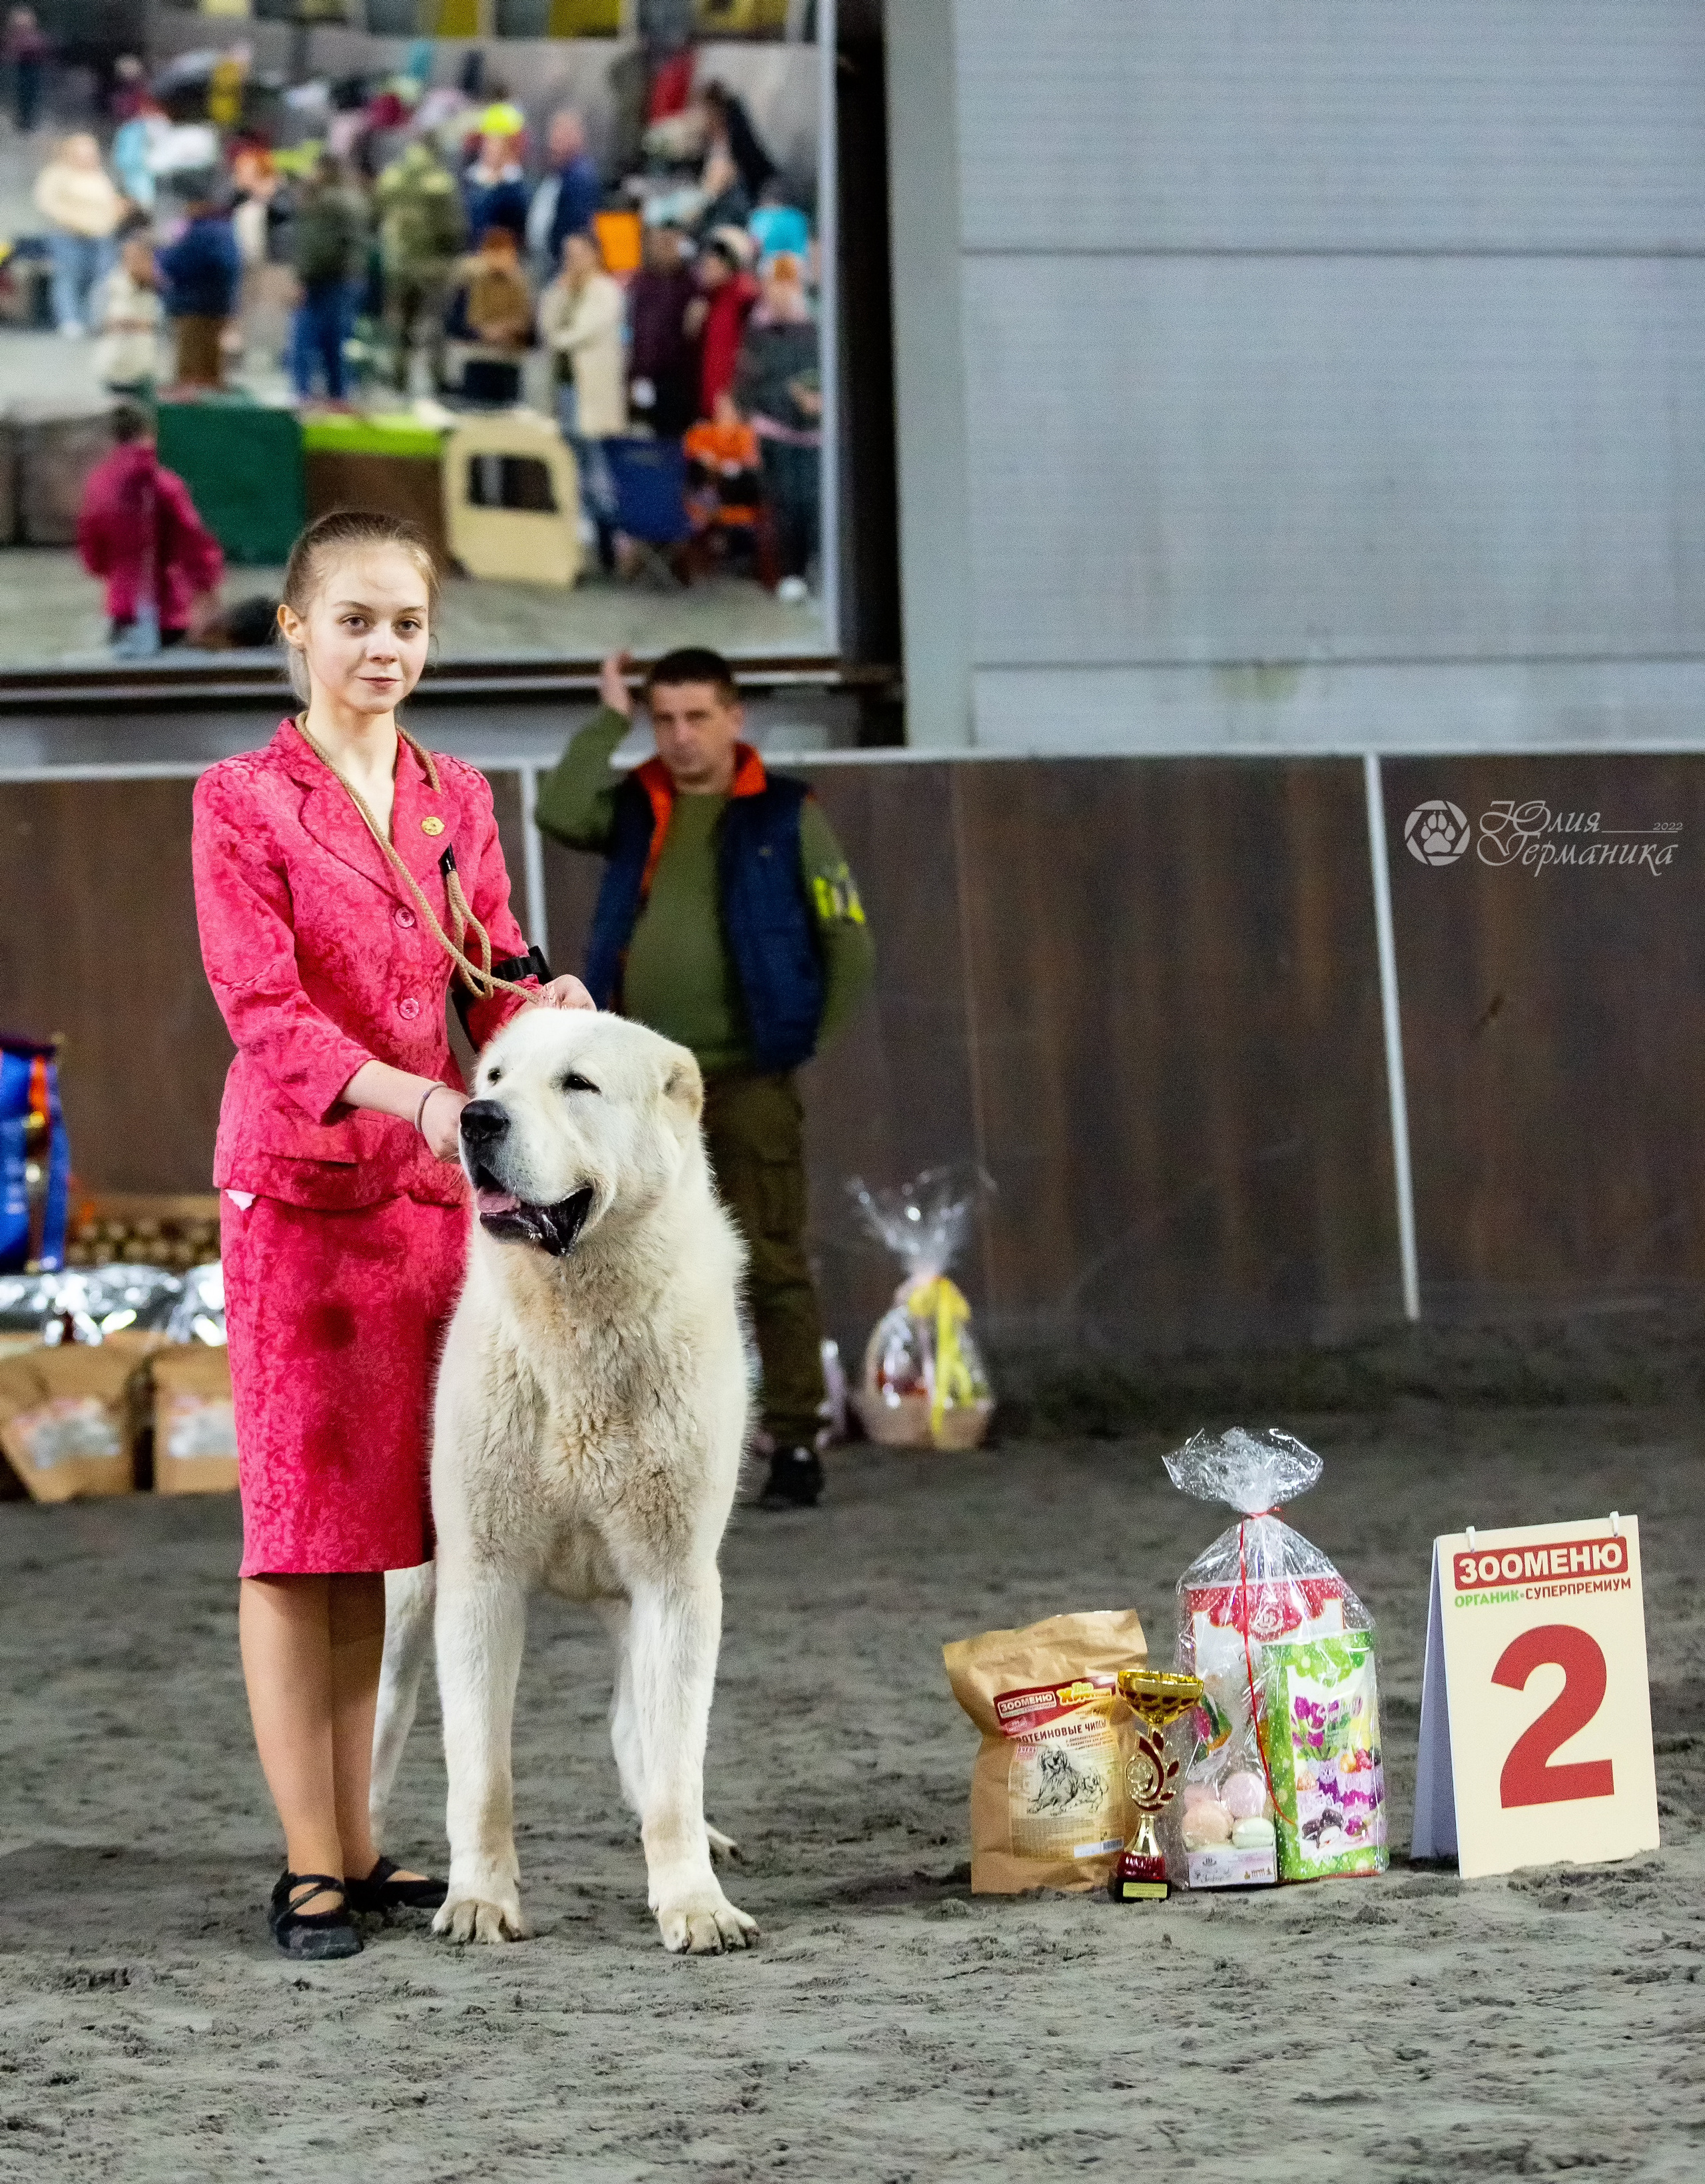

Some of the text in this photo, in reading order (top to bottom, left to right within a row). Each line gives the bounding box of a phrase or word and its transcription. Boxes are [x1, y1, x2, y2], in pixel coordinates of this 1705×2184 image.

[1459, 1542, 1623, 1584] ЗООМЕНЮ
[1000, 1694, 1053, 1712] ЗООМЕНЮ
[1491, 1623, 1614, 1809] 2
[1011, 1725, 1082, 1744] РОТЕИНОВЫЕ
[1085, 1719, 1107, 1733] ЧИПСЫ
